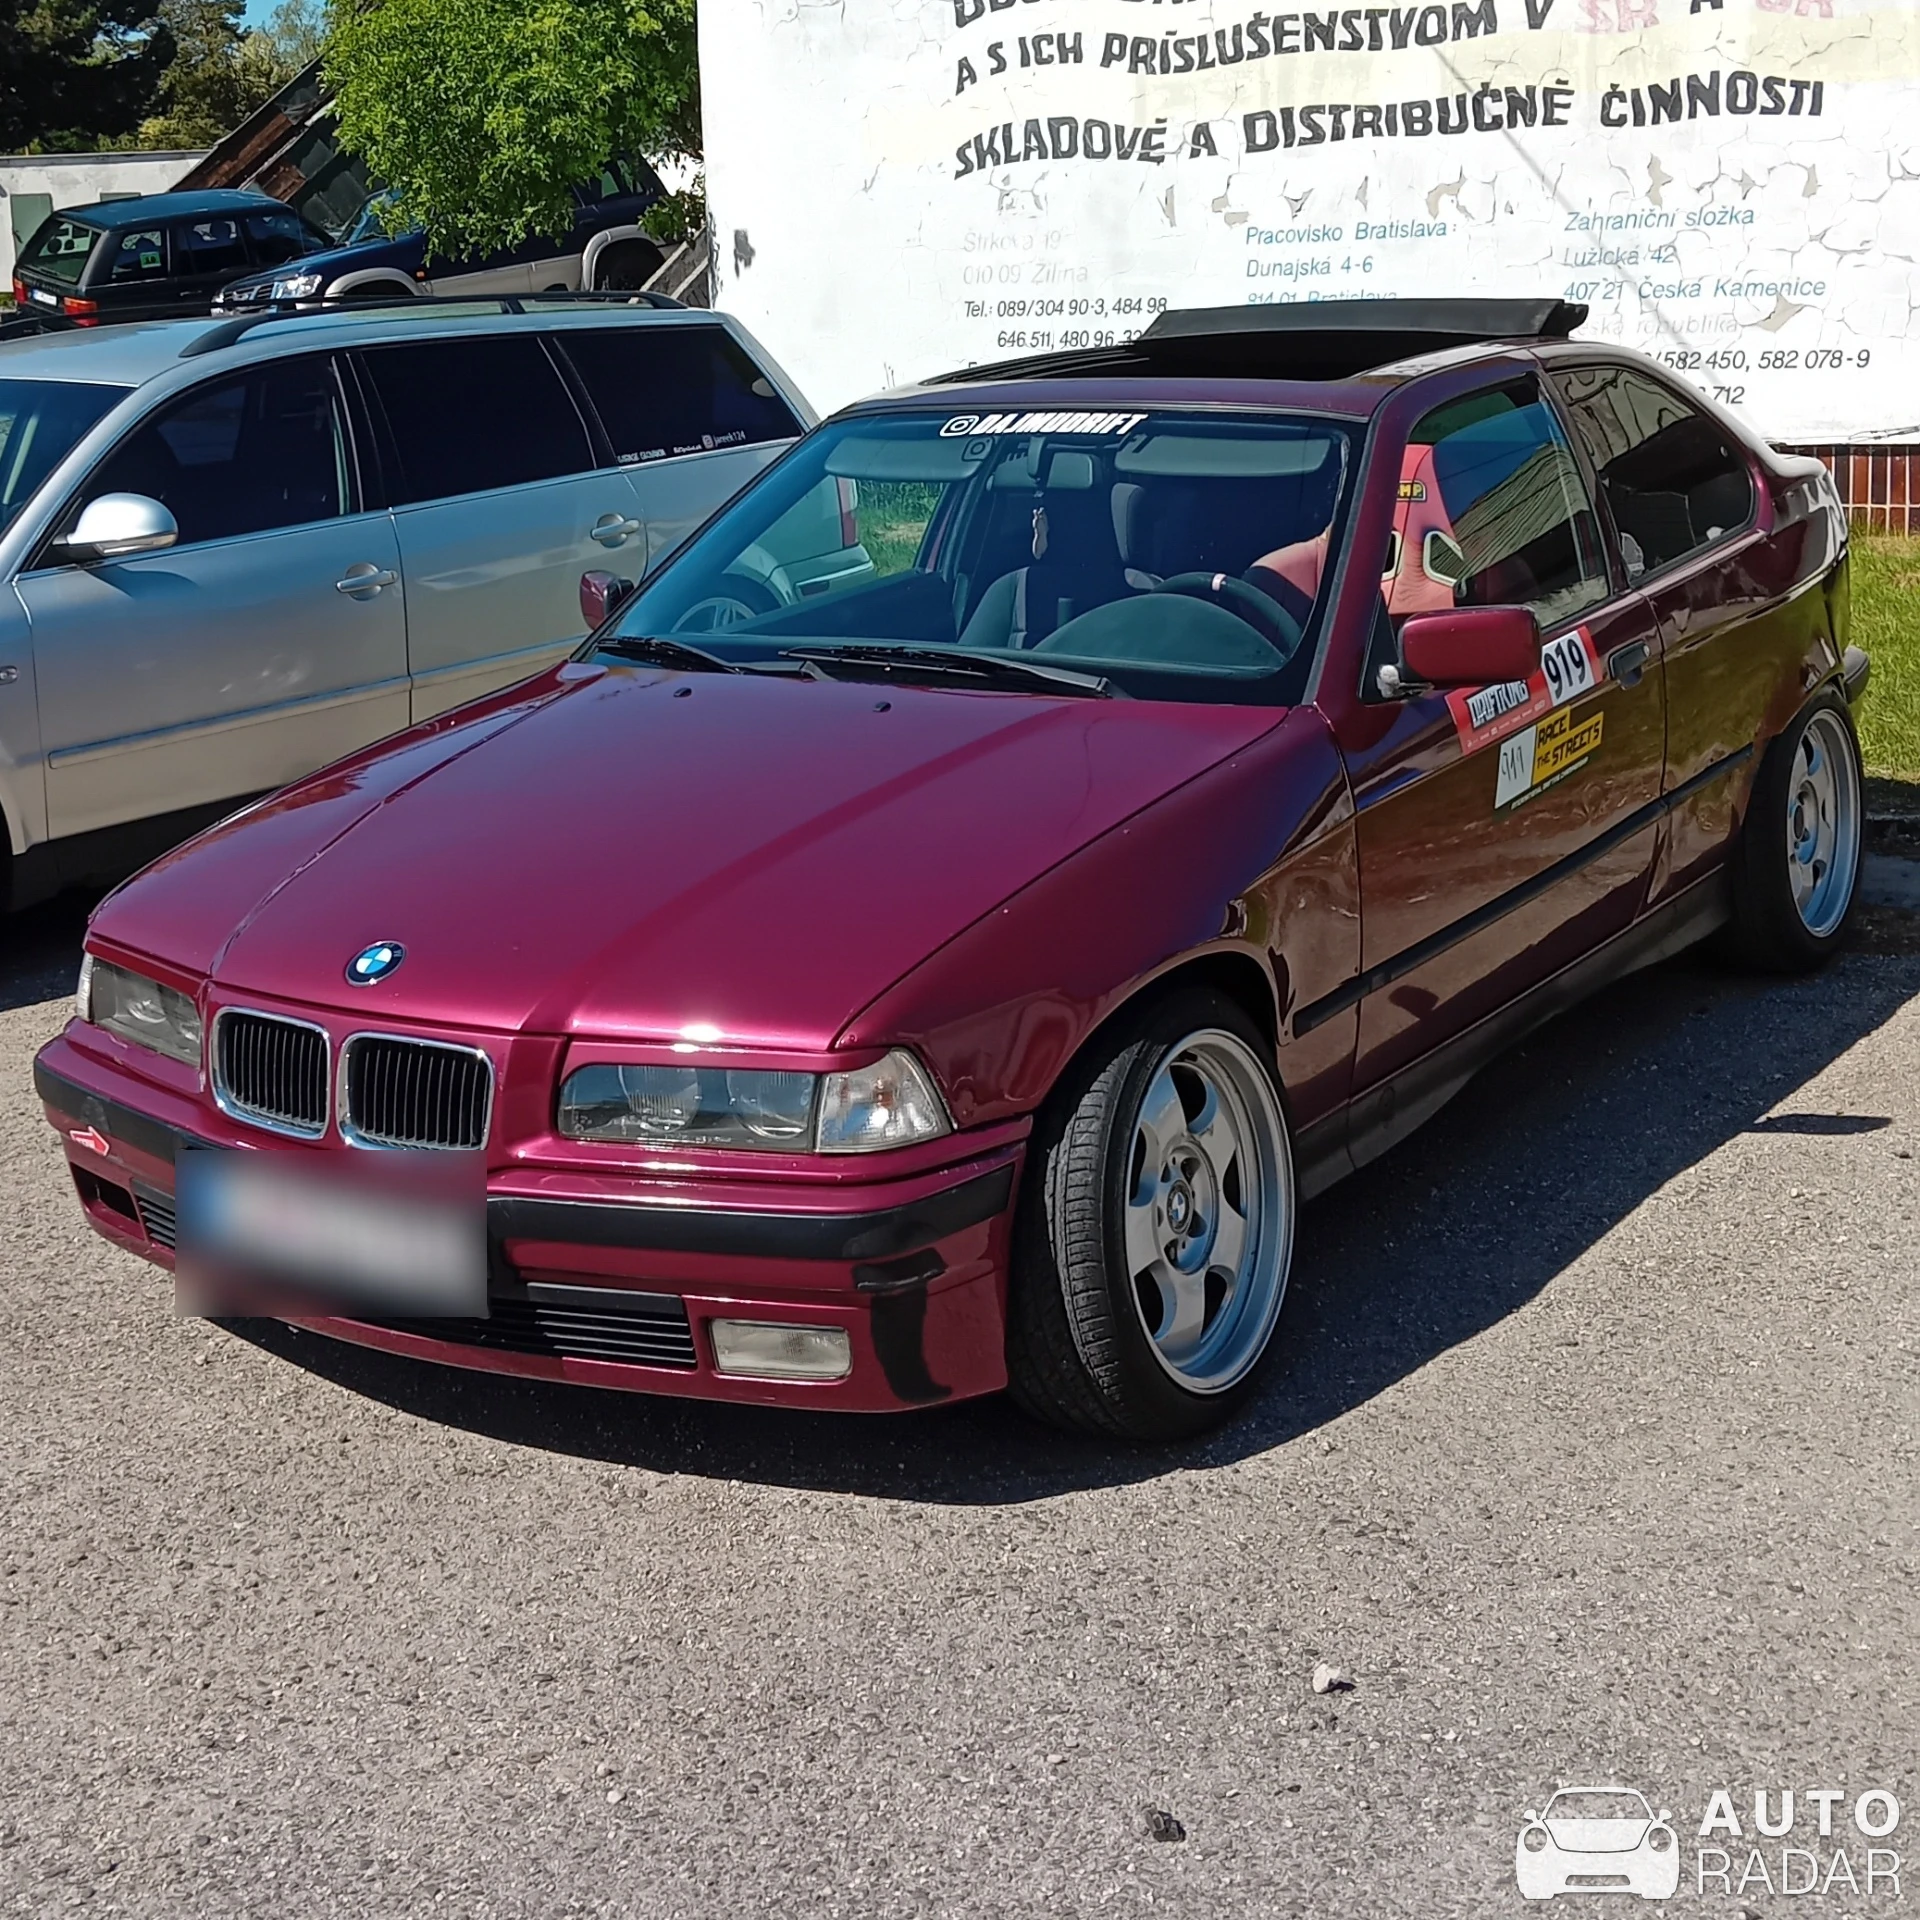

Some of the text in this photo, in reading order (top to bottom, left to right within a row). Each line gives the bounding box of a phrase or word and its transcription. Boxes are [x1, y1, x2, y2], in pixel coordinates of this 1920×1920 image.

[956, 56, 977, 96] A
[987, 41, 1007, 76] S
[1018, 32, 1083, 68] ICH
[1525, 0, 1552, 29] V
[954, 70, 1824, 181] SKLADOVÉ A DISTRIBUČNÉ ČINNOSTI
[1564, 206, 1754, 231] Zahraniční složka
[1245, 224, 1343, 245] Pracovisko
[1650, 245, 1675, 264] 42
[963, 265, 993, 285] 010
[999, 264, 1021, 284] 09
[1246, 256, 1374, 282] Dunajská 4-6
[1564, 282, 1600, 300] 407
[1602, 282, 1624, 300] 21
[1713, 277, 1826, 298] Kamenice
[964, 301, 993, 318] Tel.:
[997, 299, 1064, 317] 089/304
[1112, 297, 1142, 315] 484
[1147, 297, 1168, 314] 98
[1060, 330, 1090, 348] 480
[1706, 351, 1750, 373] 450,
[1758, 350, 1798, 369] 582
[1805, 349, 1870, 369] 078-9
[1397, 483, 1423, 498] MP
[1543, 638, 1587, 700] 919
[1537, 714, 1568, 748] RACE
[1537, 721, 1601, 770] THE STREETS
